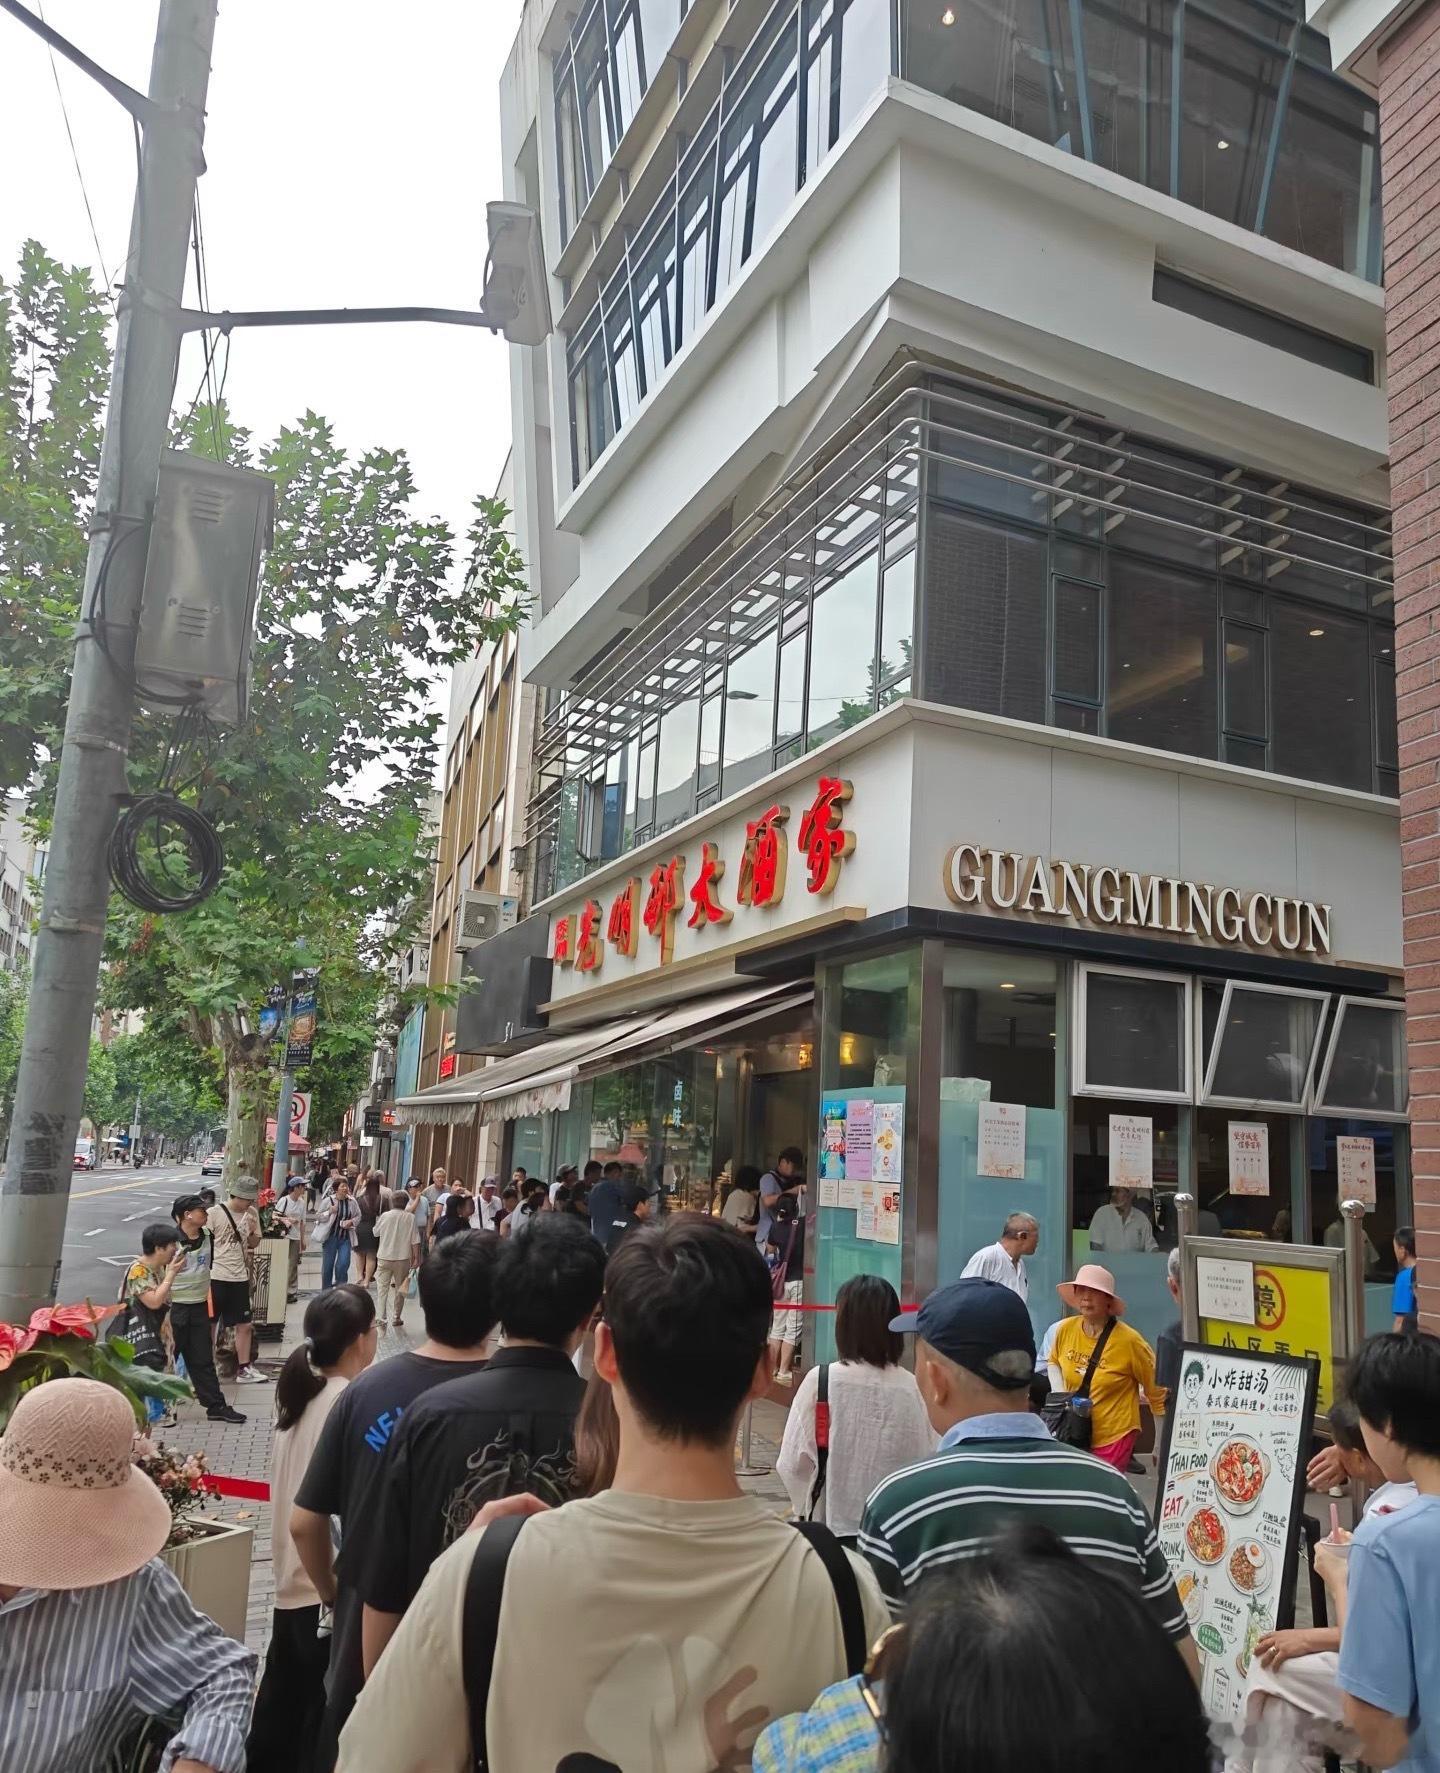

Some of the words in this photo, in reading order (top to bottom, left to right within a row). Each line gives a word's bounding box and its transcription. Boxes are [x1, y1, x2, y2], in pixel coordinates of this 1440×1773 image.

[947, 844, 1332, 954] GUANGMINGCUN
[673, 1080, 683, 1128] 卤味
[1208, 1368, 1269, 1395] 小炸甜汤
[1206, 1394, 1258, 1411] 泰式家庭料理
[1170, 1452, 1189, 1473] THAI
[1189, 1453, 1208, 1470] FOOD
[1163, 1495, 1184, 1518] EAT
